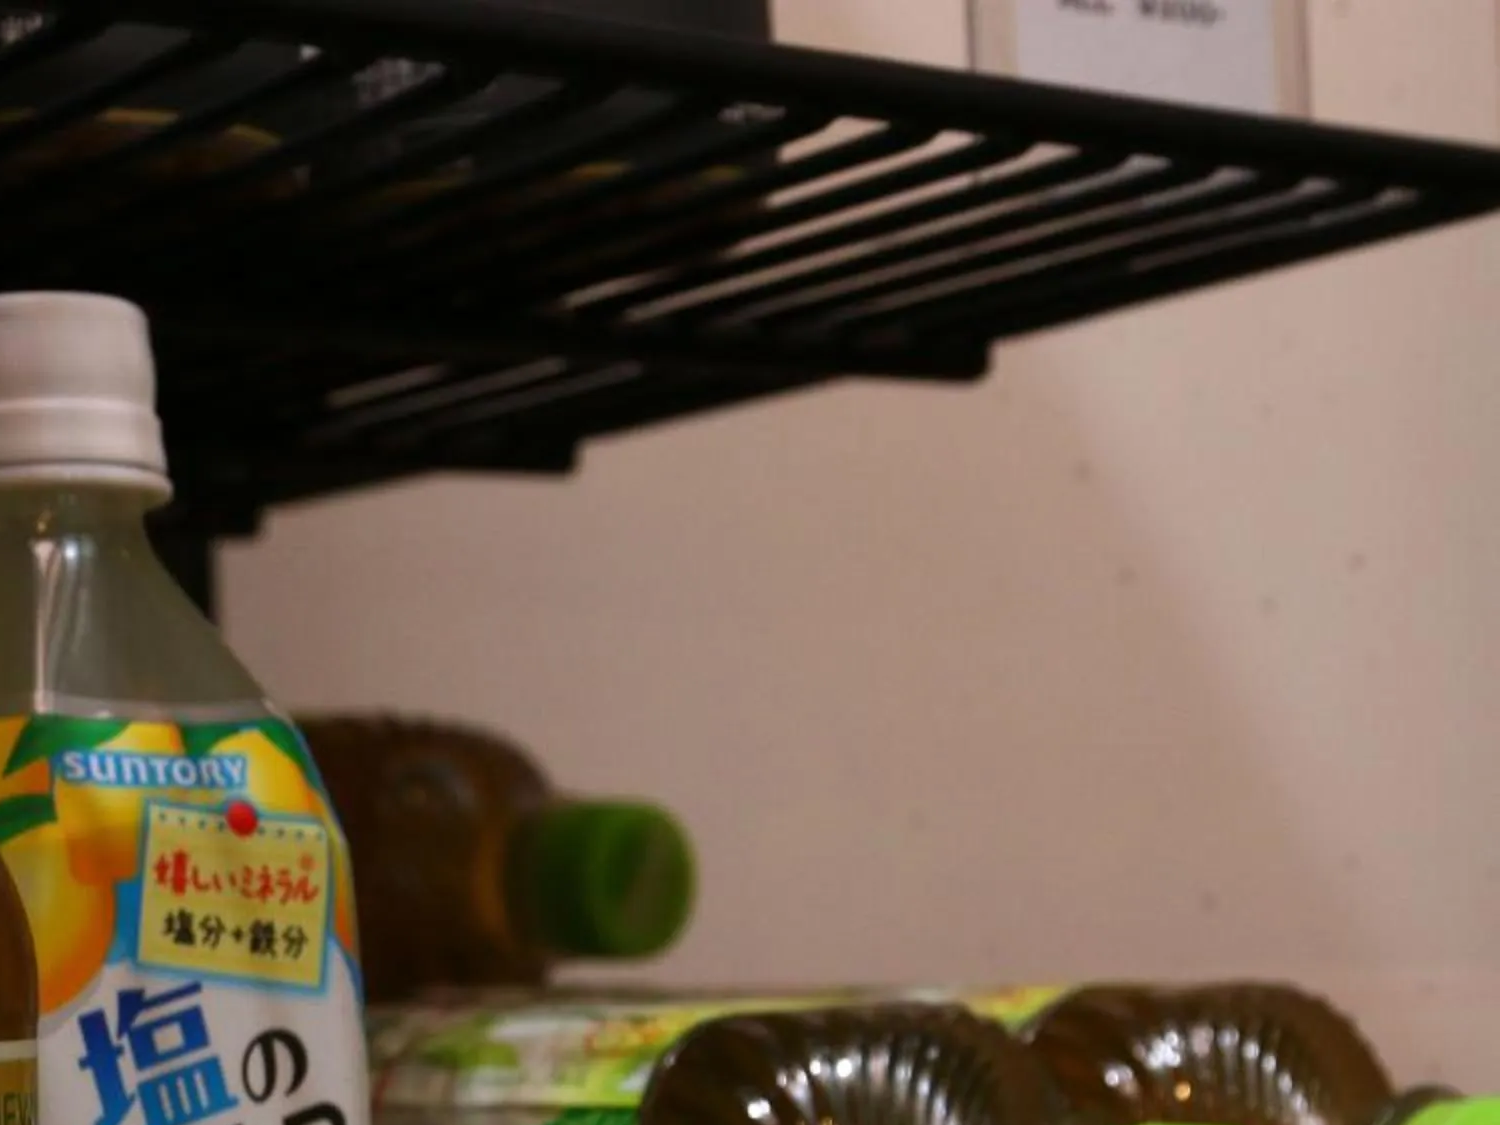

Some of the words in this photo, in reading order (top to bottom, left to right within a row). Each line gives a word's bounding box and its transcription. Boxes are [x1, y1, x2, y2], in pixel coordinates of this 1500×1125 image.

[62, 751, 246, 787] SUNTORY
[154, 849, 318, 905] 嬉しいミネラル
[163, 909, 308, 958] 塩分+鉄分
